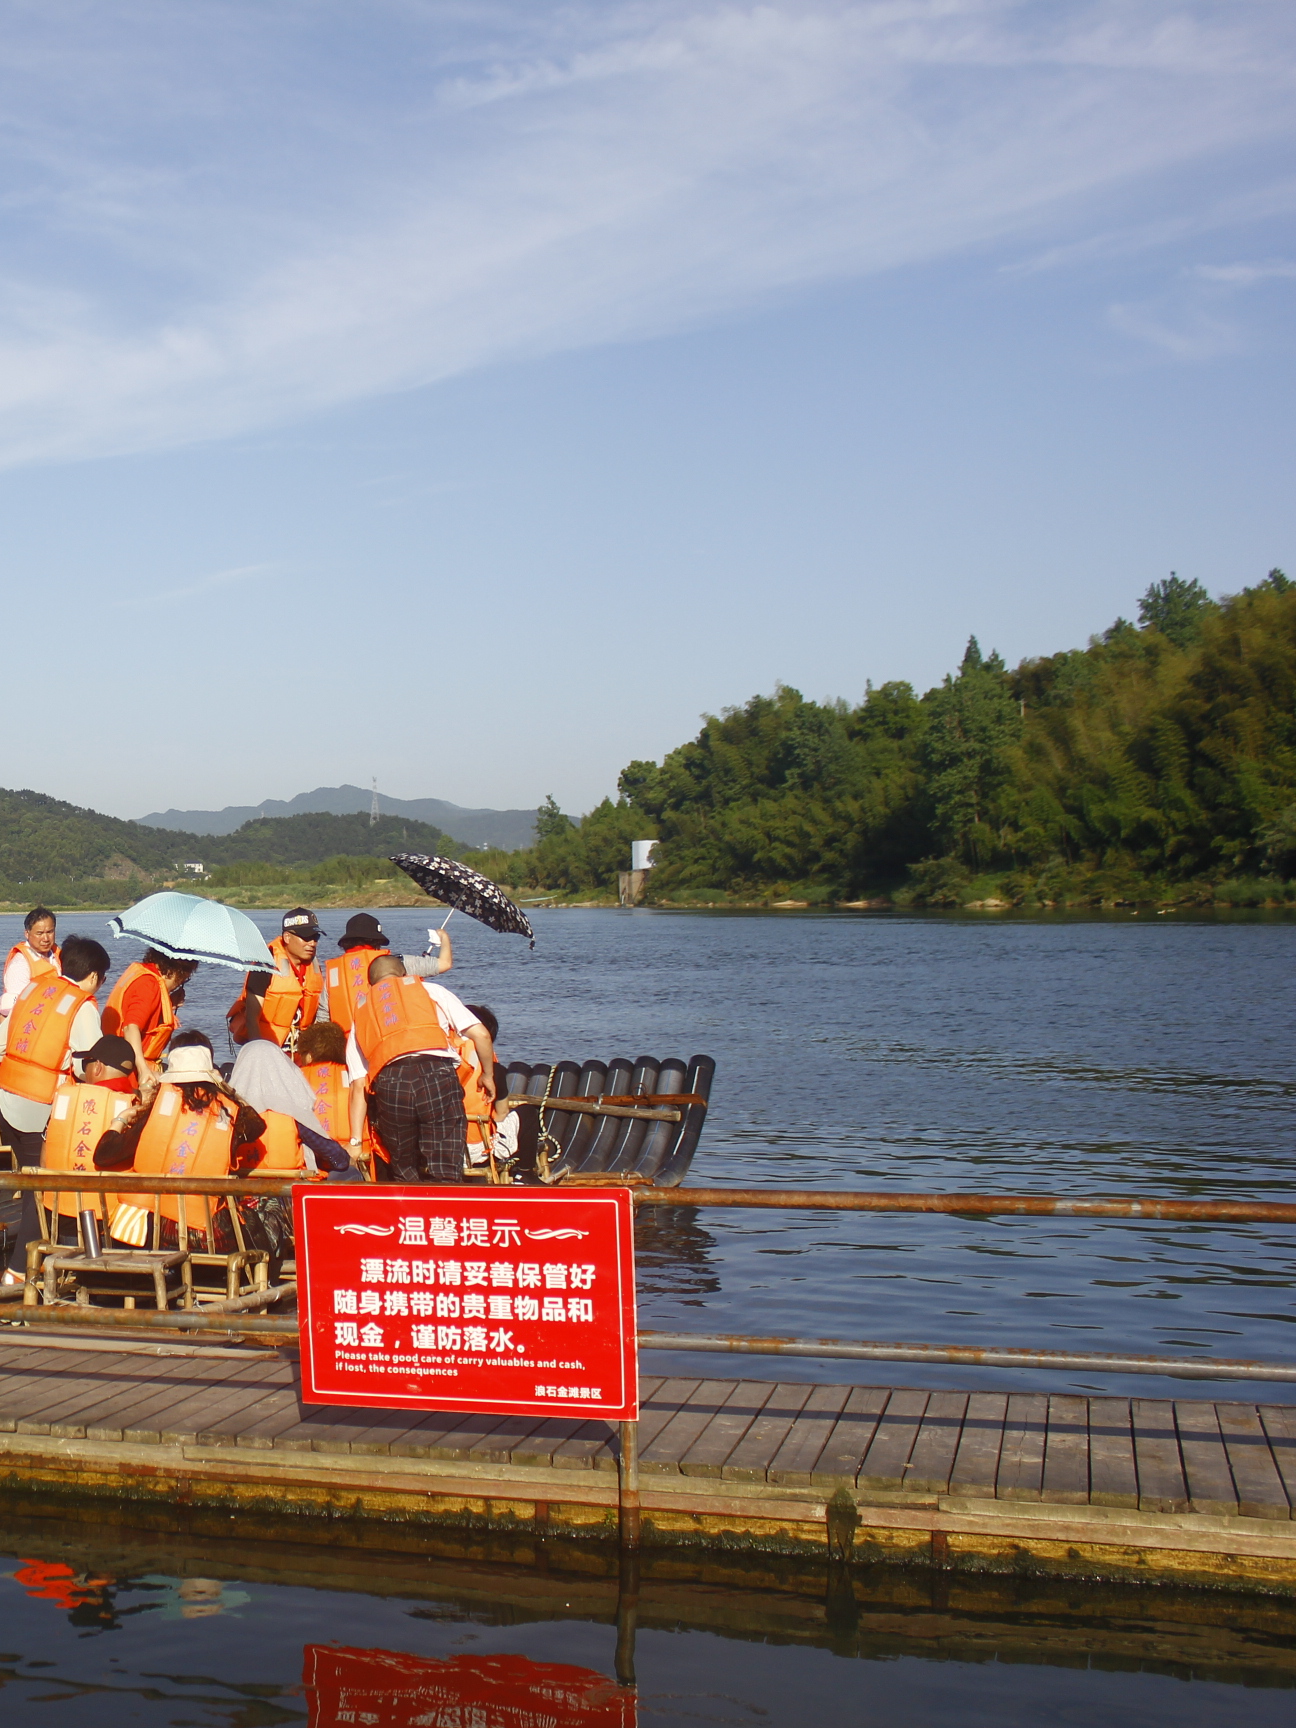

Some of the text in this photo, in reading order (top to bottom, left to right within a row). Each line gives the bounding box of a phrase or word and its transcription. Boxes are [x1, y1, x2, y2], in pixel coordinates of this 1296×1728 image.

[397, 1216, 521, 1248] 温馨提示
[360, 1258, 596, 1290] 漂流时请妥善保管好
[333, 1289, 593, 1322] 随身携带的贵重物品和
[335, 1350, 586, 1371] Please take good care of carry valuables and cash,
[335, 1362, 458, 1377] if lost, the consequences
[534, 1385, 602, 1399] 浪石金滩景区
